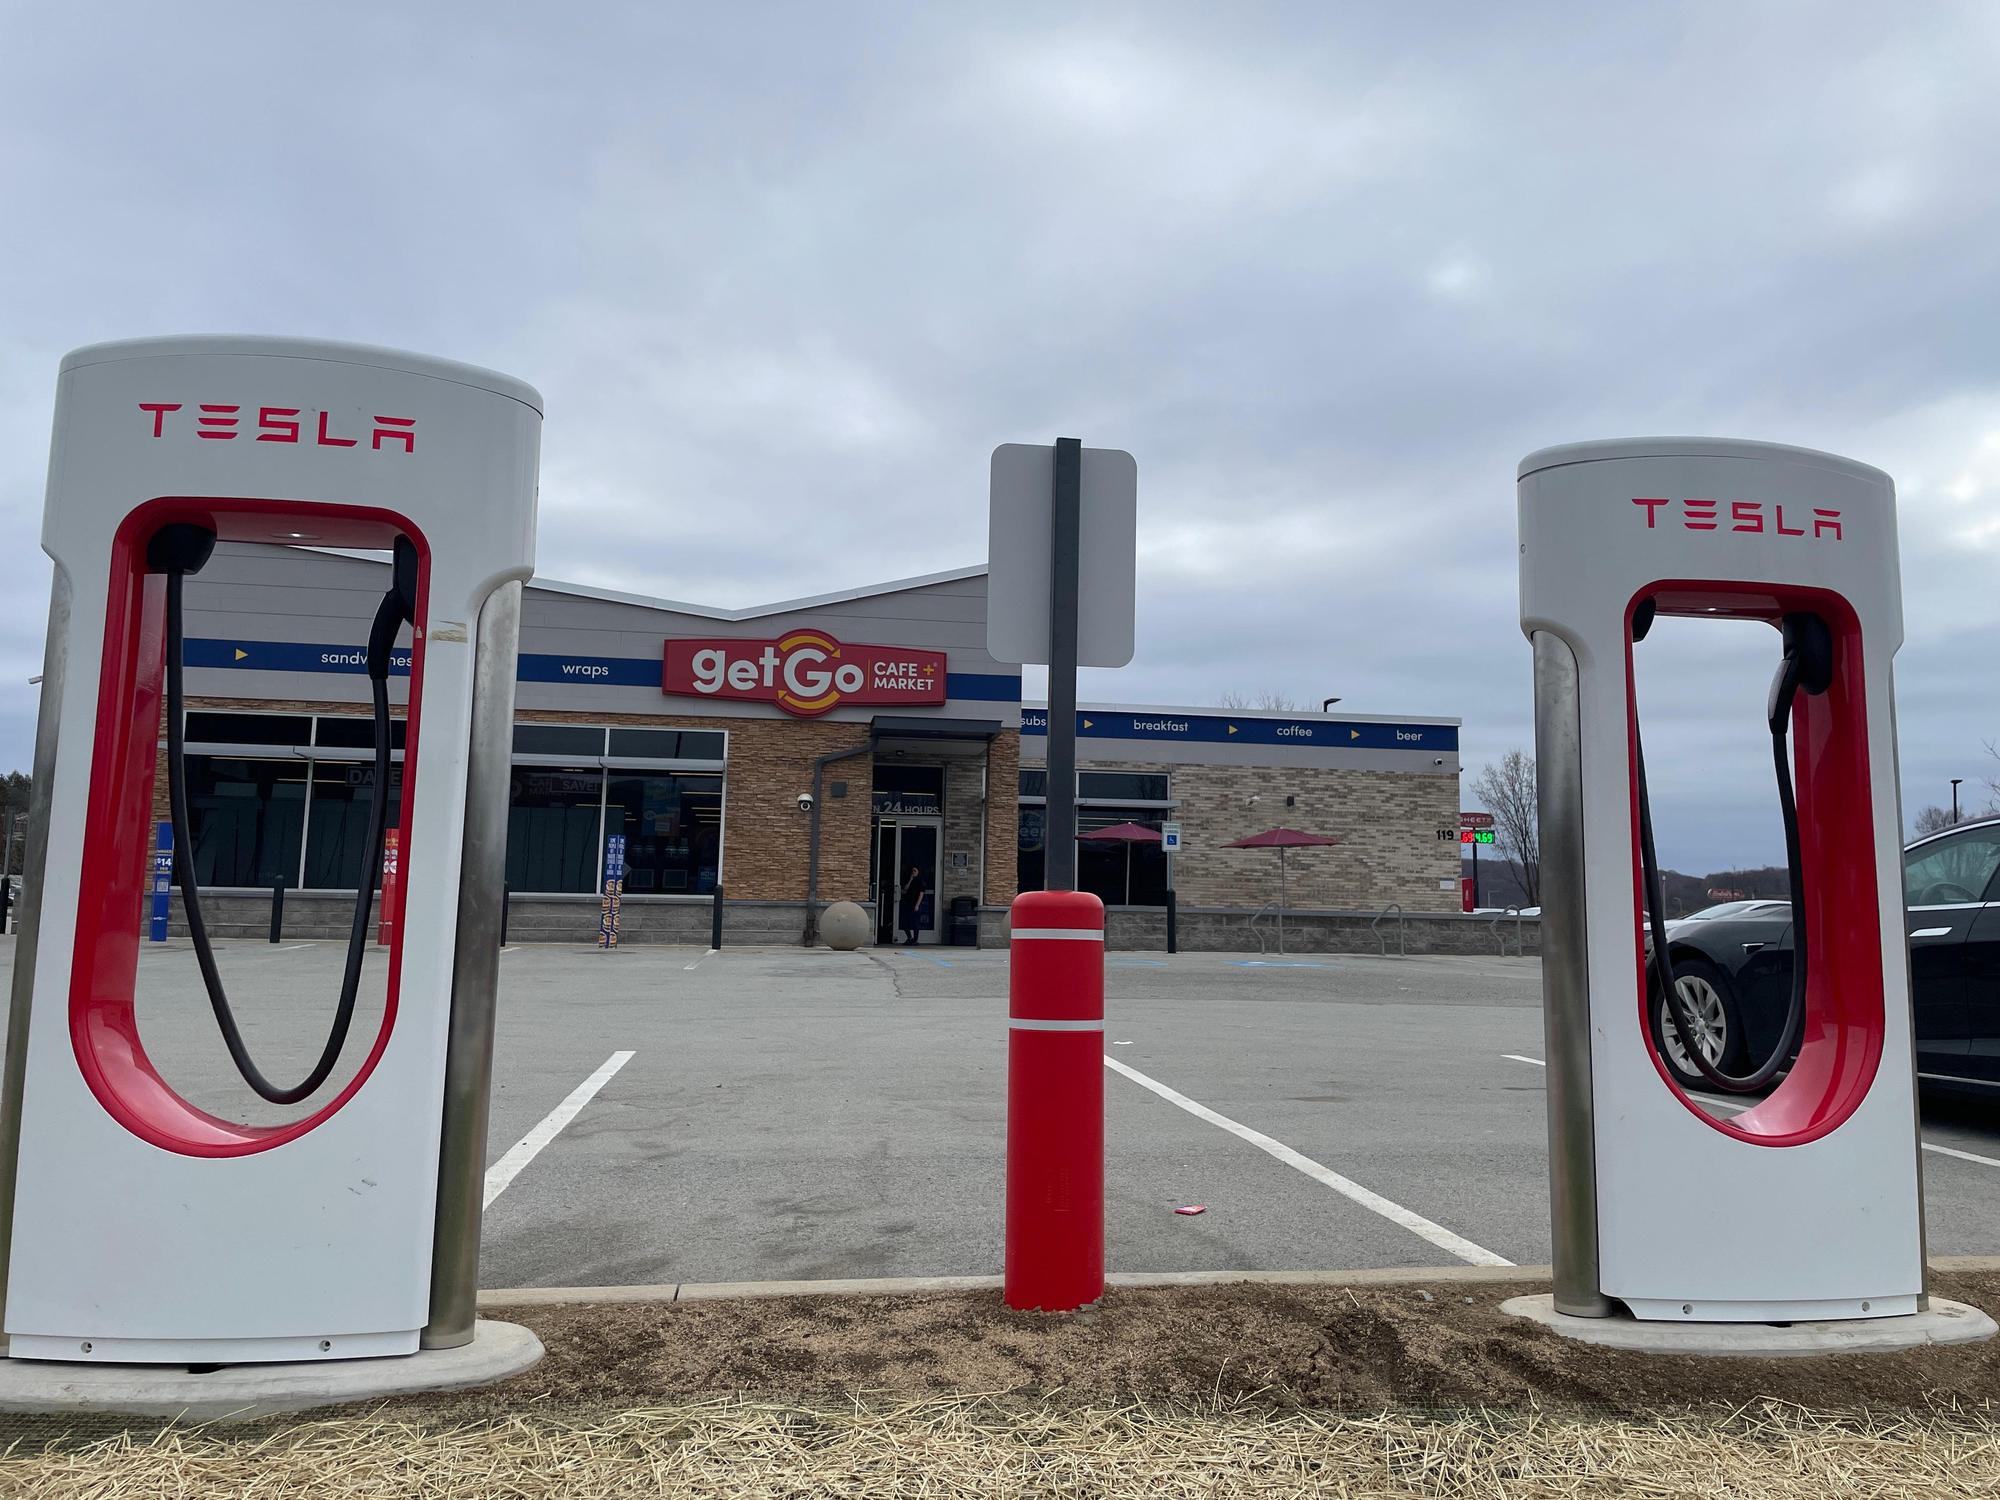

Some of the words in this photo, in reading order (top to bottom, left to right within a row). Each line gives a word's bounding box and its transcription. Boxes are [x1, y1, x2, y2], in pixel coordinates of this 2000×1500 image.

[138, 403, 416, 453] TESLA
[1632, 498, 1842, 540] TESLA
[562, 665, 609, 679] wraps
[692, 647, 864, 694] getGo
[874, 661, 918, 677] CAFE
[874, 677, 934, 691] MARKET
[1133, 719, 1189, 732] breakfast
[1276, 726, 1313, 737] coffee
[1396, 730, 1423, 741] beer
[884, 801, 902, 814] 24
[904, 805, 940, 815] HOURS
[1436, 829, 1454, 840] 119
[1475, 831, 1493, 844] 4.69
